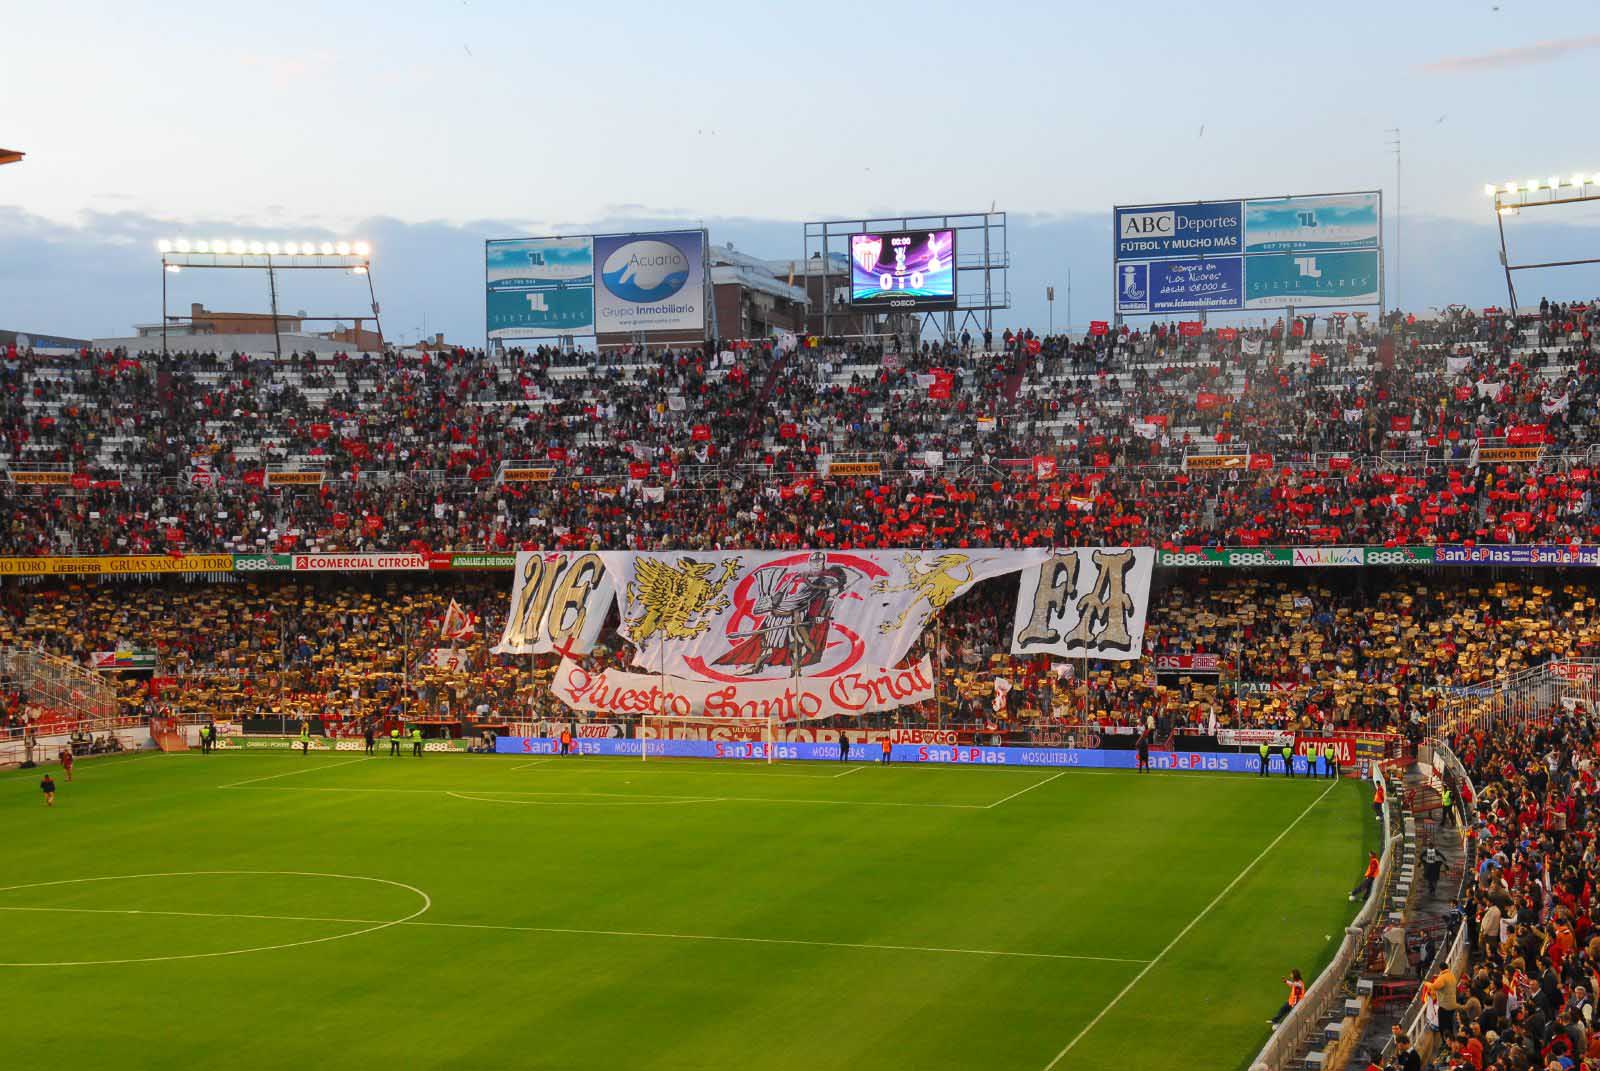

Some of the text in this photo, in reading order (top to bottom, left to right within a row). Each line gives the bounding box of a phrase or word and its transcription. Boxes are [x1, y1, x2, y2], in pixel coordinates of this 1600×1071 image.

[1125, 215, 1237, 233] ABC Deportes
[1120, 236, 1237, 252] FÚTBOL Y MUCHO MÁS
[628, 253, 681, 266] Acuario
[880, 271, 924, 290] 0 0
[602, 303, 695, 318] Grupo Inmobiliario
[110, 558, 233, 571] GRUAS SANCHO TORO
[236, 559, 290, 570] 888.com
[310, 557, 375, 569] COMERCIAL
[1163, 553, 1223, 566] 888.com
[1229, 552, 1290, 566] 888.com
[1367, 551, 1431, 565] 888.com
[17, 560, 46, 572] TORO
[52, 563, 101, 573] LIEBHERR
[1018, 549, 1136, 652] FA
[1157, 655, 1180, 669] as
[704, 685, 822, 722] Santo
[829, 665, 932, 711] Grial
[424, 742, 464, 752] 888.com
[918, 746, 1078, 764] SanJePlas MOSQUITERAS
